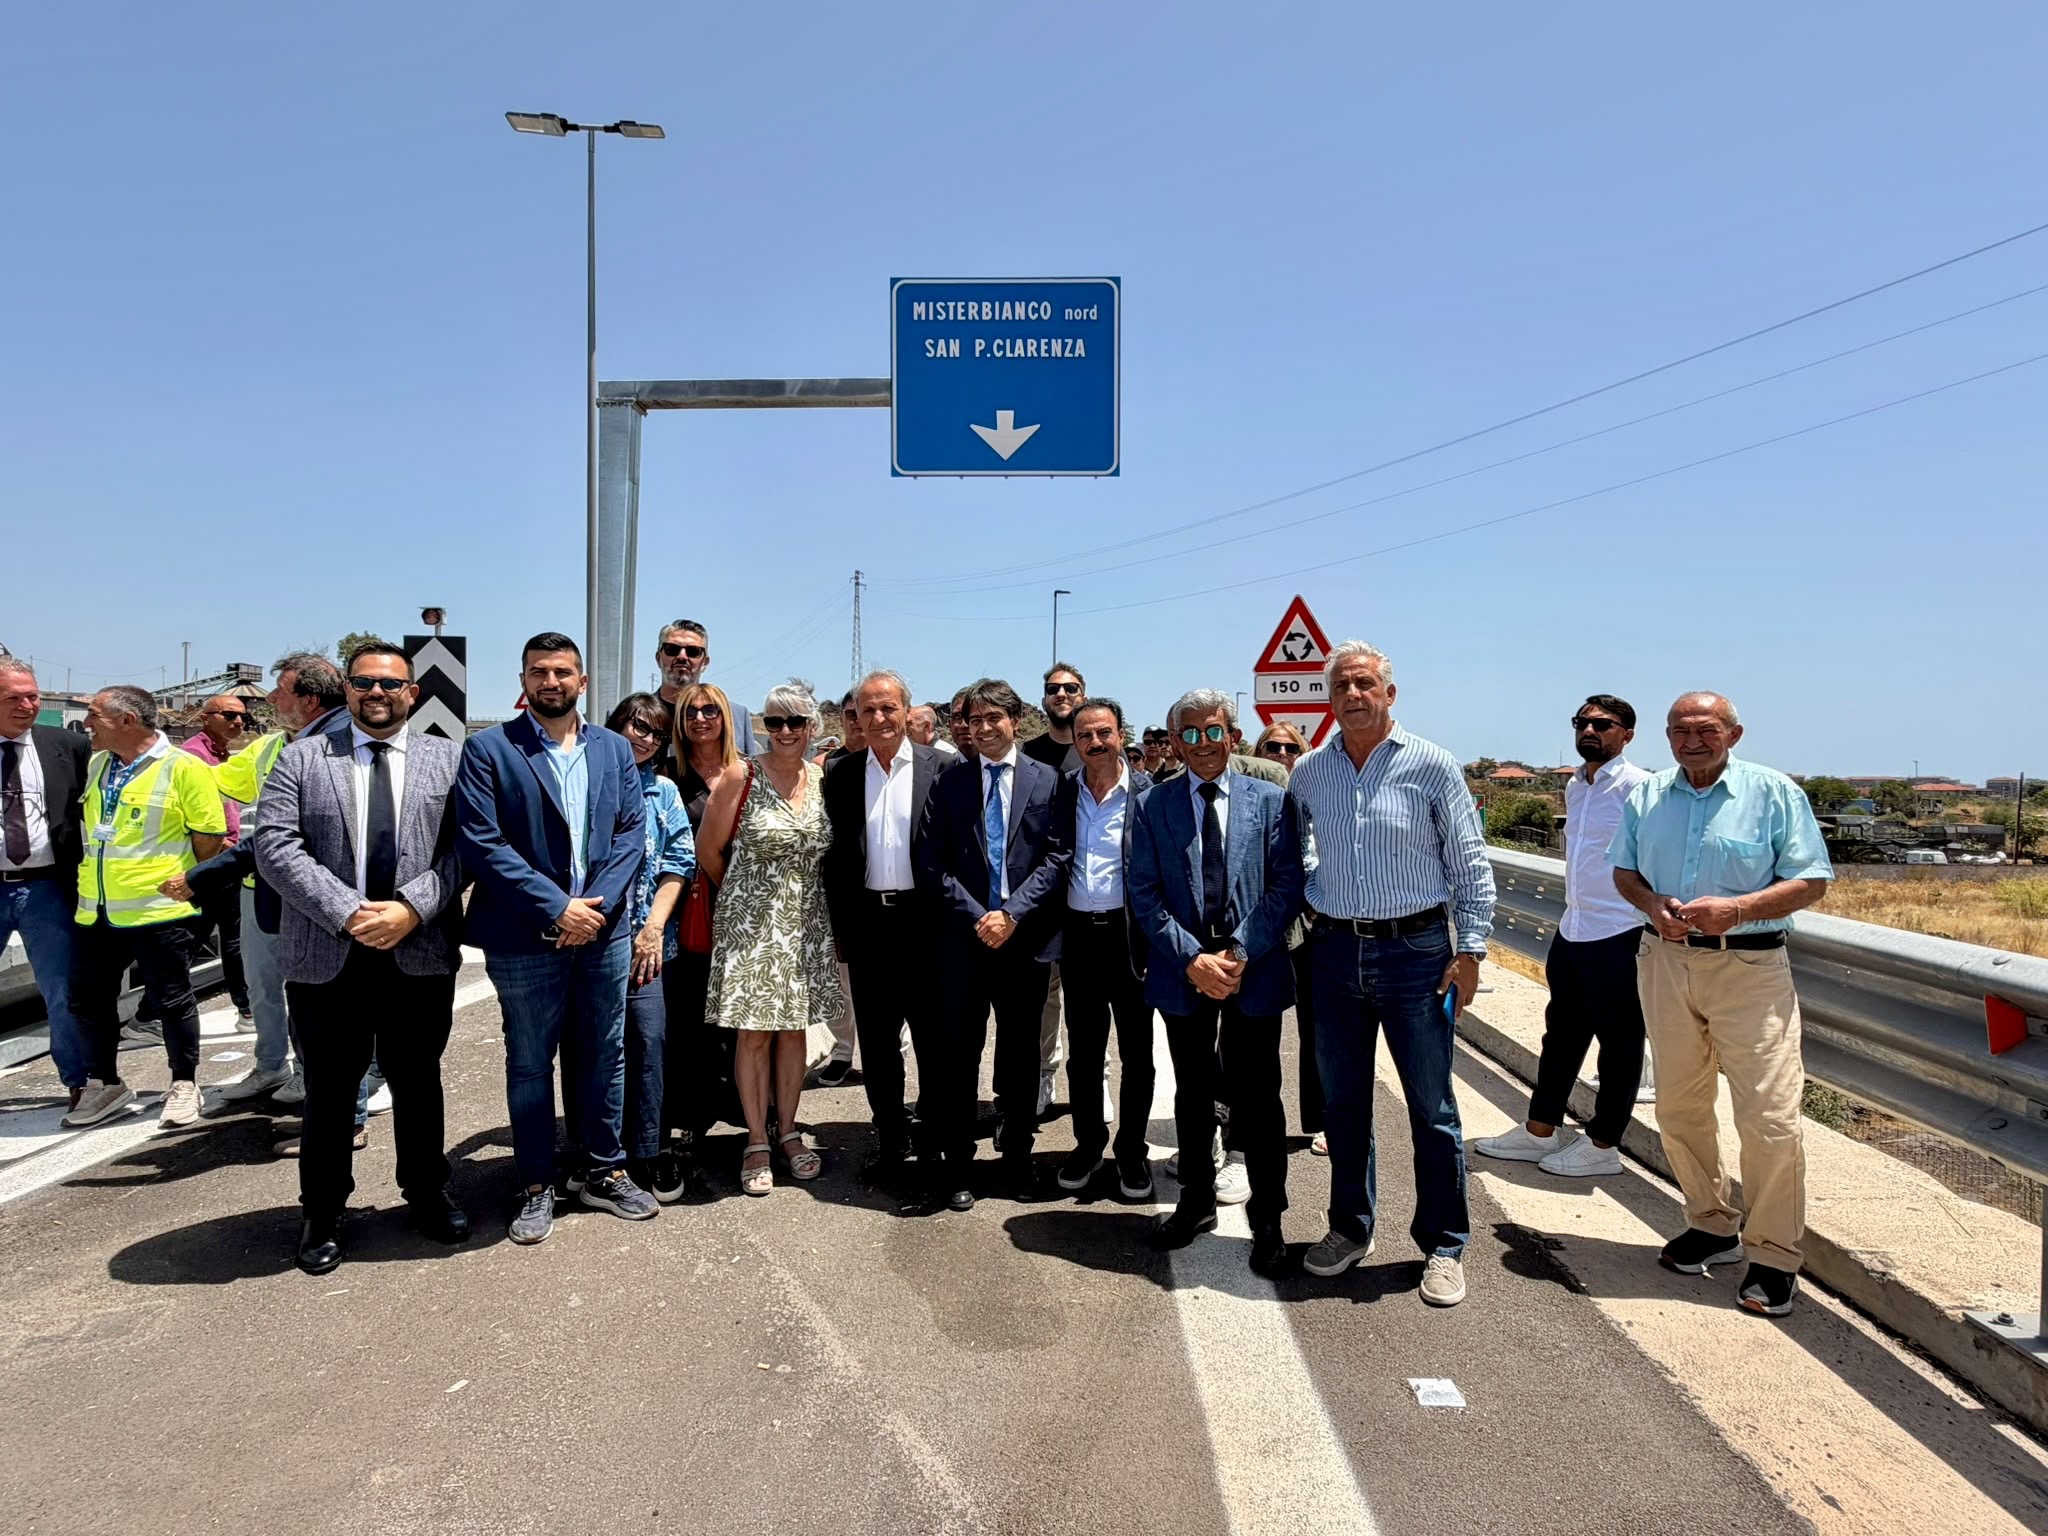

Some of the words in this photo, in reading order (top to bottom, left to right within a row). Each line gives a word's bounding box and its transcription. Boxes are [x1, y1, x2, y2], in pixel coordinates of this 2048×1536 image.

[912, 301, 1052, 321] MISTERBIANCO
[1064, 304, 1098, 321] nord
[925, 338, 961, 358] SAN
[974, 338, 1086, 358] P.CLARENZA
[1271, 681, 1300, 693] 150
[1309, 682, 1323, 692] m
